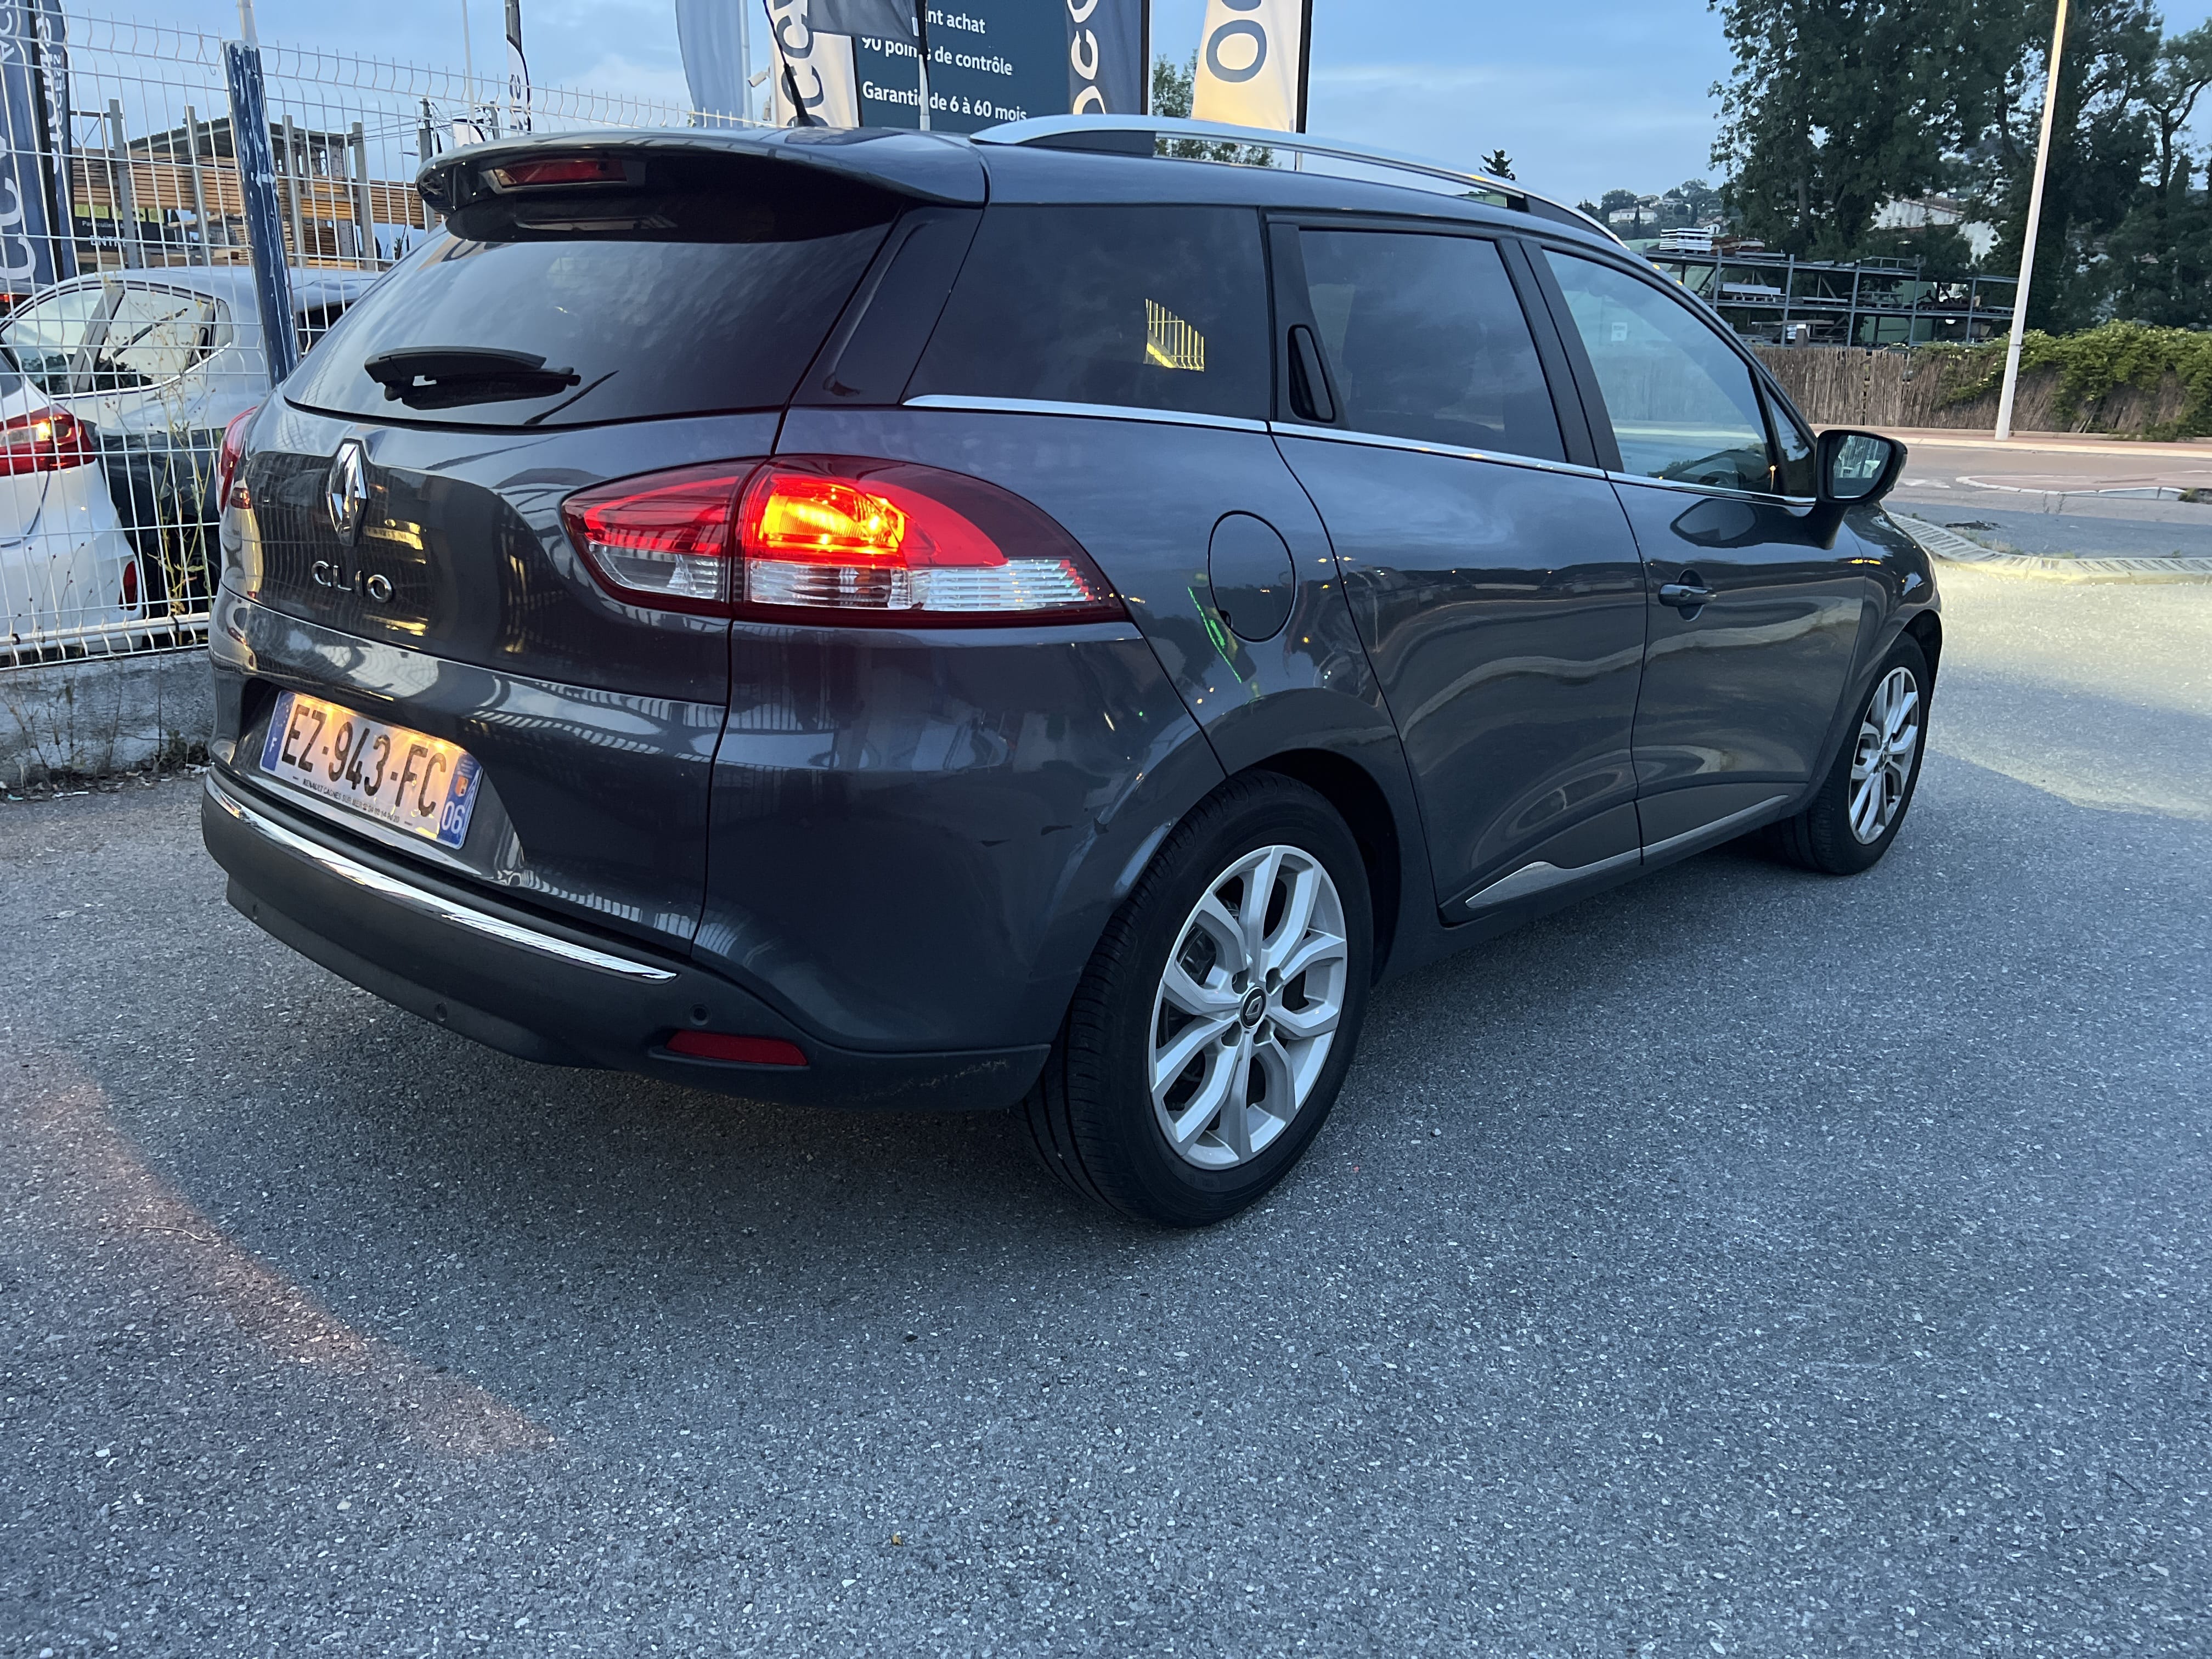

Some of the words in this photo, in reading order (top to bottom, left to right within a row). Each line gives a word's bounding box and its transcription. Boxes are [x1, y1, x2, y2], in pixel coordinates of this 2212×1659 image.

[947, 13, 986, 33] achat
[935, 46, 952, 64] de
[956, 53, 1013, 76] contrôle
[862, 81, 922, 106] Garanti
[930, 92, 947, 110] de
[949, 95, 959, 112] 6
[962, 97, 971, 115] à
[974, 100, 991, 117] 60
[995, 106, 1027, 121] mois
[311, 560, 393, 603] CLIO
[269, 737, 278, 753] F
[281, 704, 447, 817] EZ-943-FC
[303, 778, 324, 793] RENAULT
[323, 787, 341, 800] CAGNES
[441, 800, 466, 834] 06
